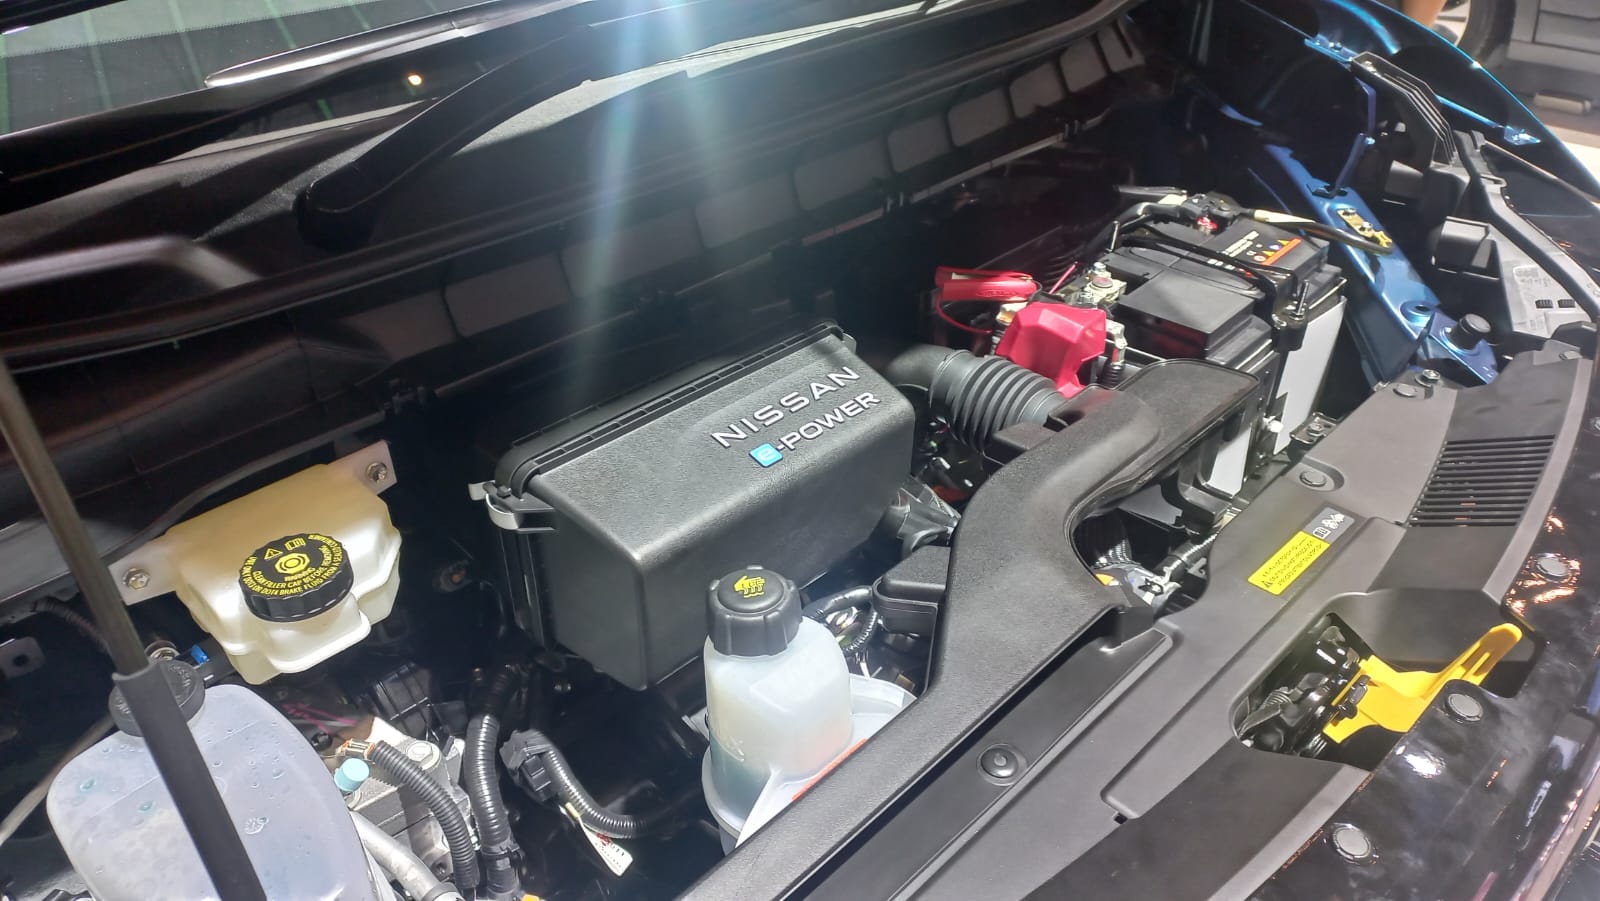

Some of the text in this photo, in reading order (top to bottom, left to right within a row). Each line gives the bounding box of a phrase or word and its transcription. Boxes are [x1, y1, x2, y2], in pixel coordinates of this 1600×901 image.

[711, 366, 861, 448] NISSAN
[287, 579, 302, 588] CAP
[280, 586, 303, 596] BRAKE
